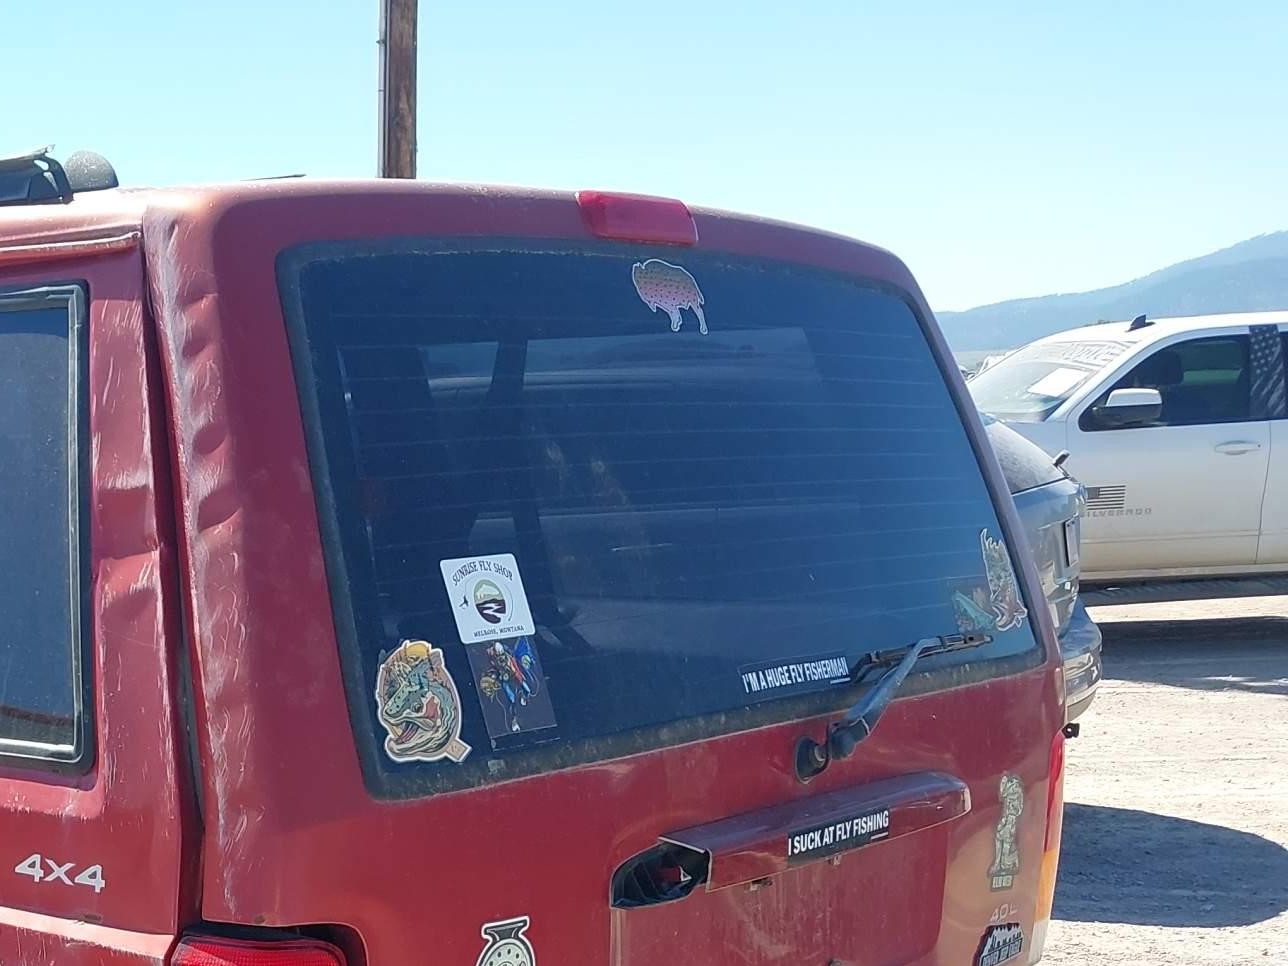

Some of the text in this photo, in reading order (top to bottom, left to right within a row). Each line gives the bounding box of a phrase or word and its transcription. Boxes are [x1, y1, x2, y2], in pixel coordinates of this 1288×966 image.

[452, 560, 513, 586] SUNRISE FLY SHOP
[499, 625, 524, 634] MONTANA
[742, 656, 849, 693] I'M A HUGE FLY FISHERMAN
[788, 810, 889, 856] I SUCK AT FLY FISHING
